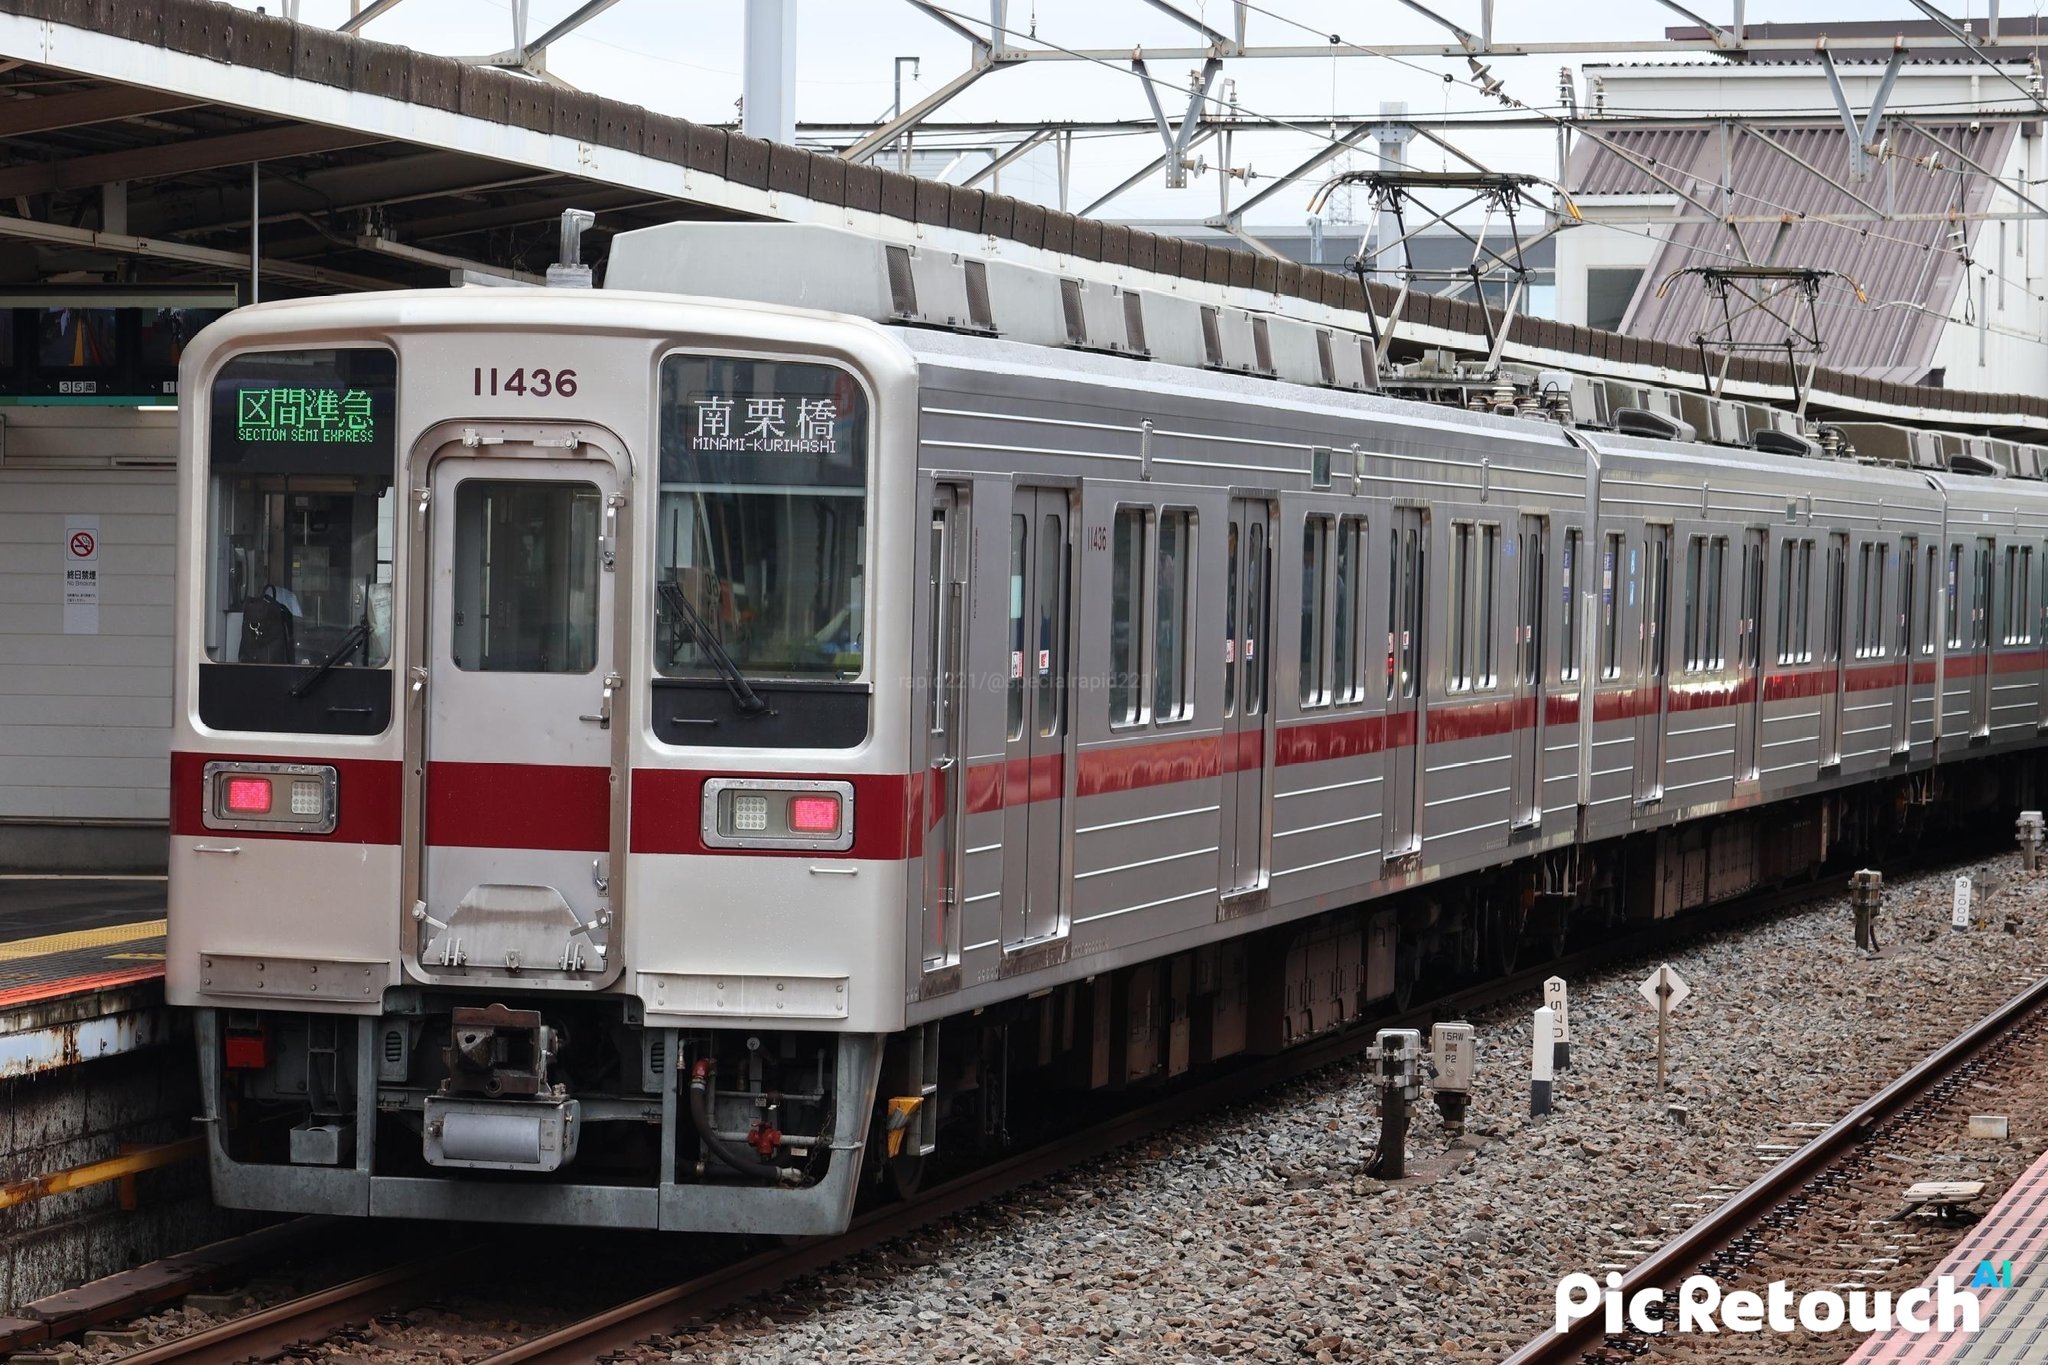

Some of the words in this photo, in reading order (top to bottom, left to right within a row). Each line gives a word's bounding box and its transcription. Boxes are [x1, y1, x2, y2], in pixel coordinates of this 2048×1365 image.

[475, 368, 577, 397] 11436
[239, 388, 374, 428] 区間準急
[694, 396, 837, 439] 南栗橋
[239, 429, 287, 441] SECTION
[291, 430, 318, 442] SEMI
[323, 430, 373, 442] EXPRESS
[693, 437, 836, 453] MINAMI-KURIHASHI
[1087, 526, 1107, 551] 11436
[1957, 894, 1966, 922] 1000
[1549, 982, 1561, 993] R
[1445, 1054, 1457, 1063] P2
